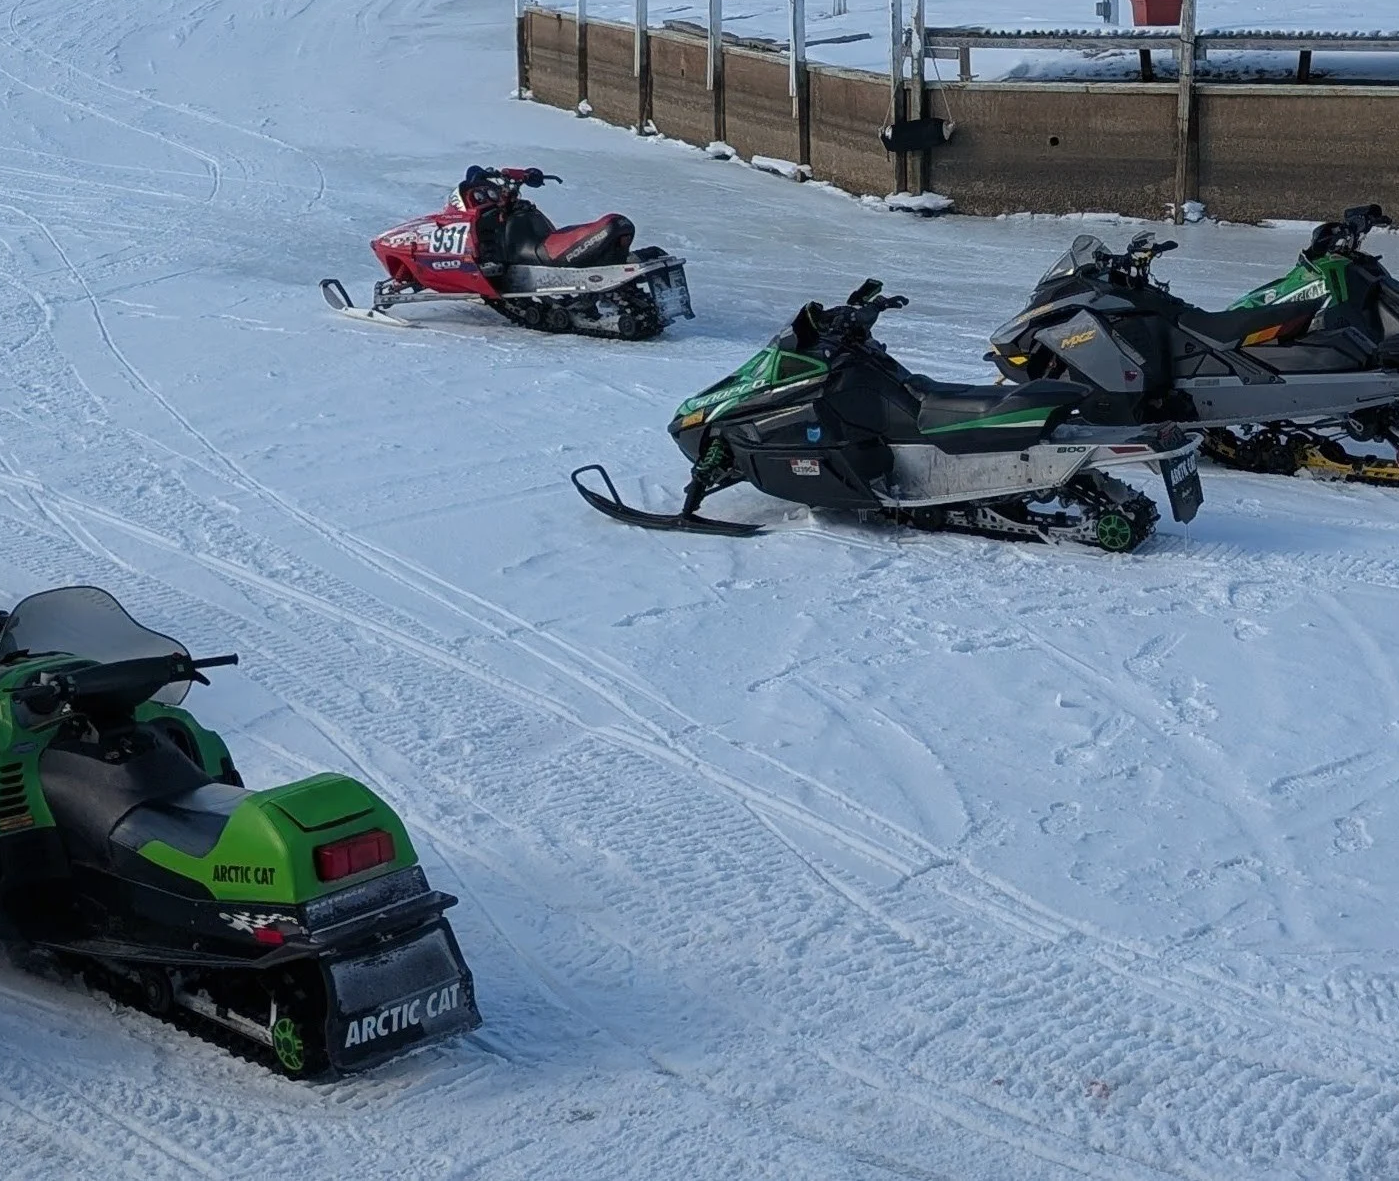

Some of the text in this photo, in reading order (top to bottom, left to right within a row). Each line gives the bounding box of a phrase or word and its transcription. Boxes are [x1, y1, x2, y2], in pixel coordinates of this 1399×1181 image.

[433, 226, 467, 253] 931
[565, 228, 608, 262] POLARIS
[432, 260, 461, 269] 600
[213, 865, 276, 885] ARCTIC CAT
[345, 982, 460, 1048] ARCTIC CAT
